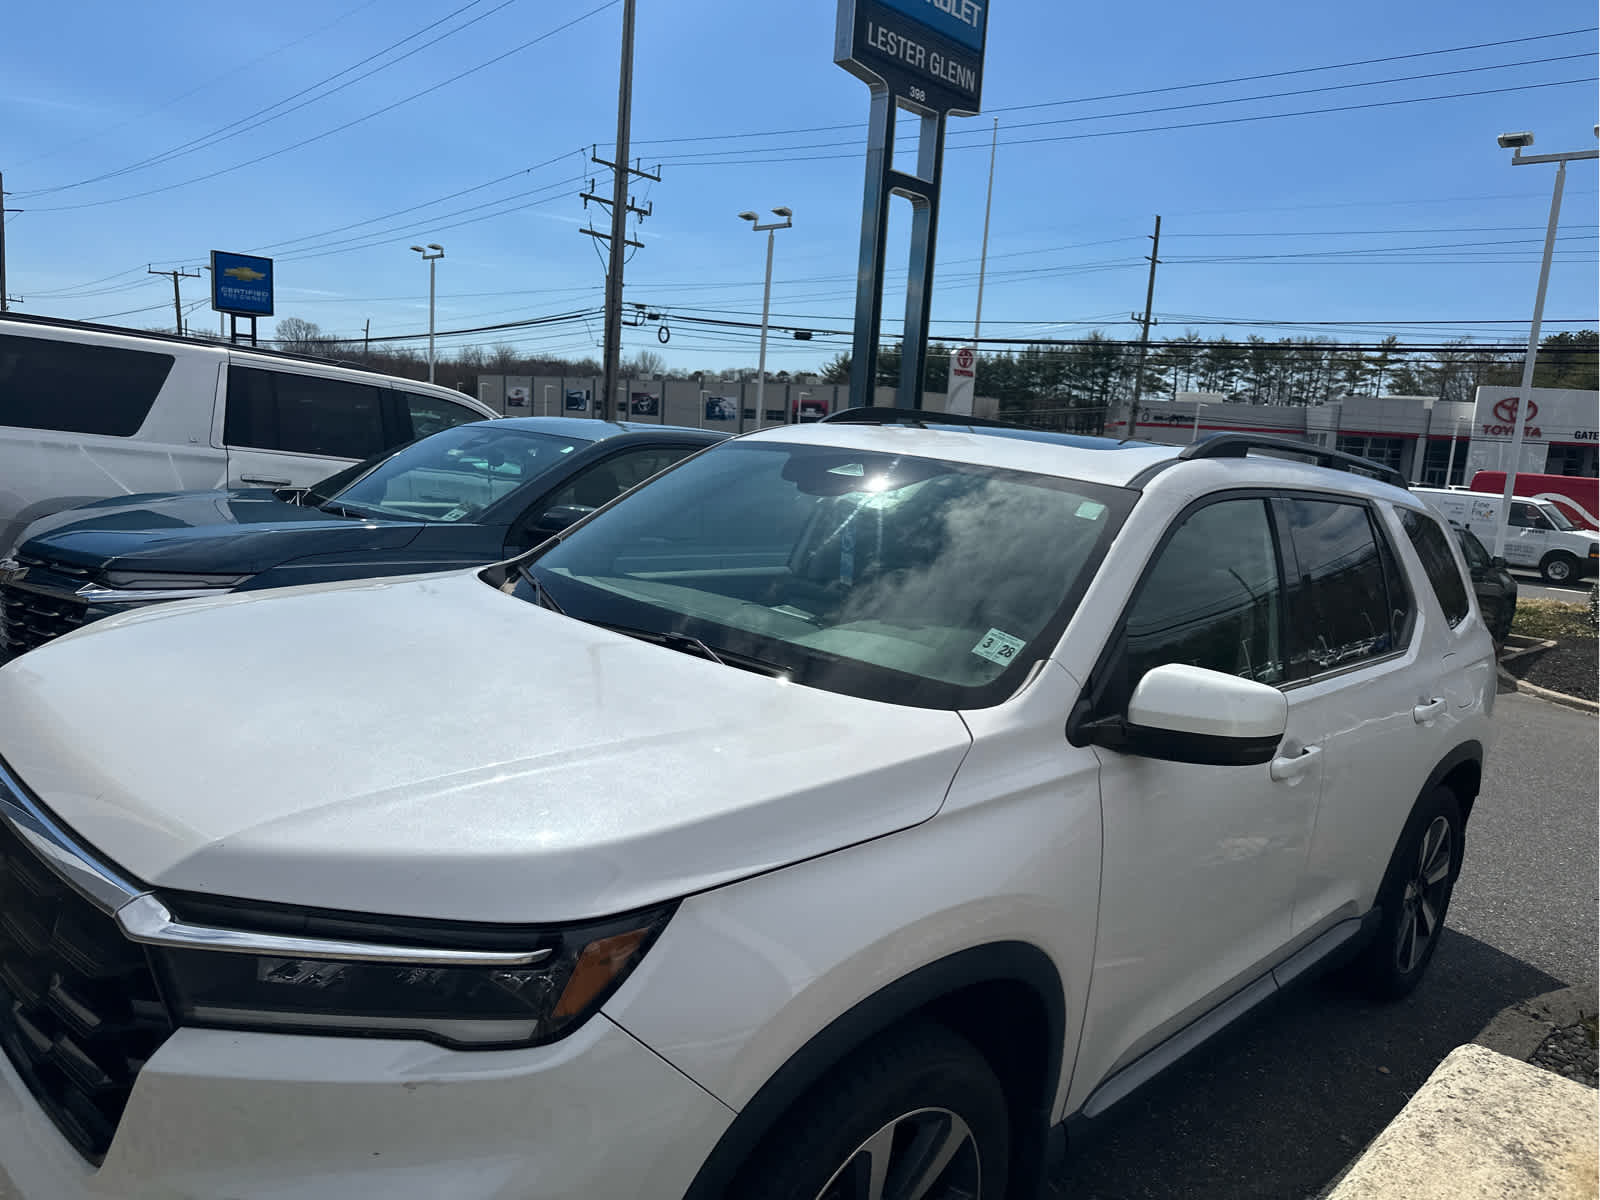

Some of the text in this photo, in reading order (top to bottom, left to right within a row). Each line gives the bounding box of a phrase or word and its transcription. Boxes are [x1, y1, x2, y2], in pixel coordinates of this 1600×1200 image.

[867, 21, 976, 93] LESTER GLENN
[909, 86, 926, 101] 398
[1482, 424, 1542, 438] TOYTA
[1574, 430, 1599, 441] GATE
[983, 638, 994, 648] 3
[998, 645, 1015, 658] 28
